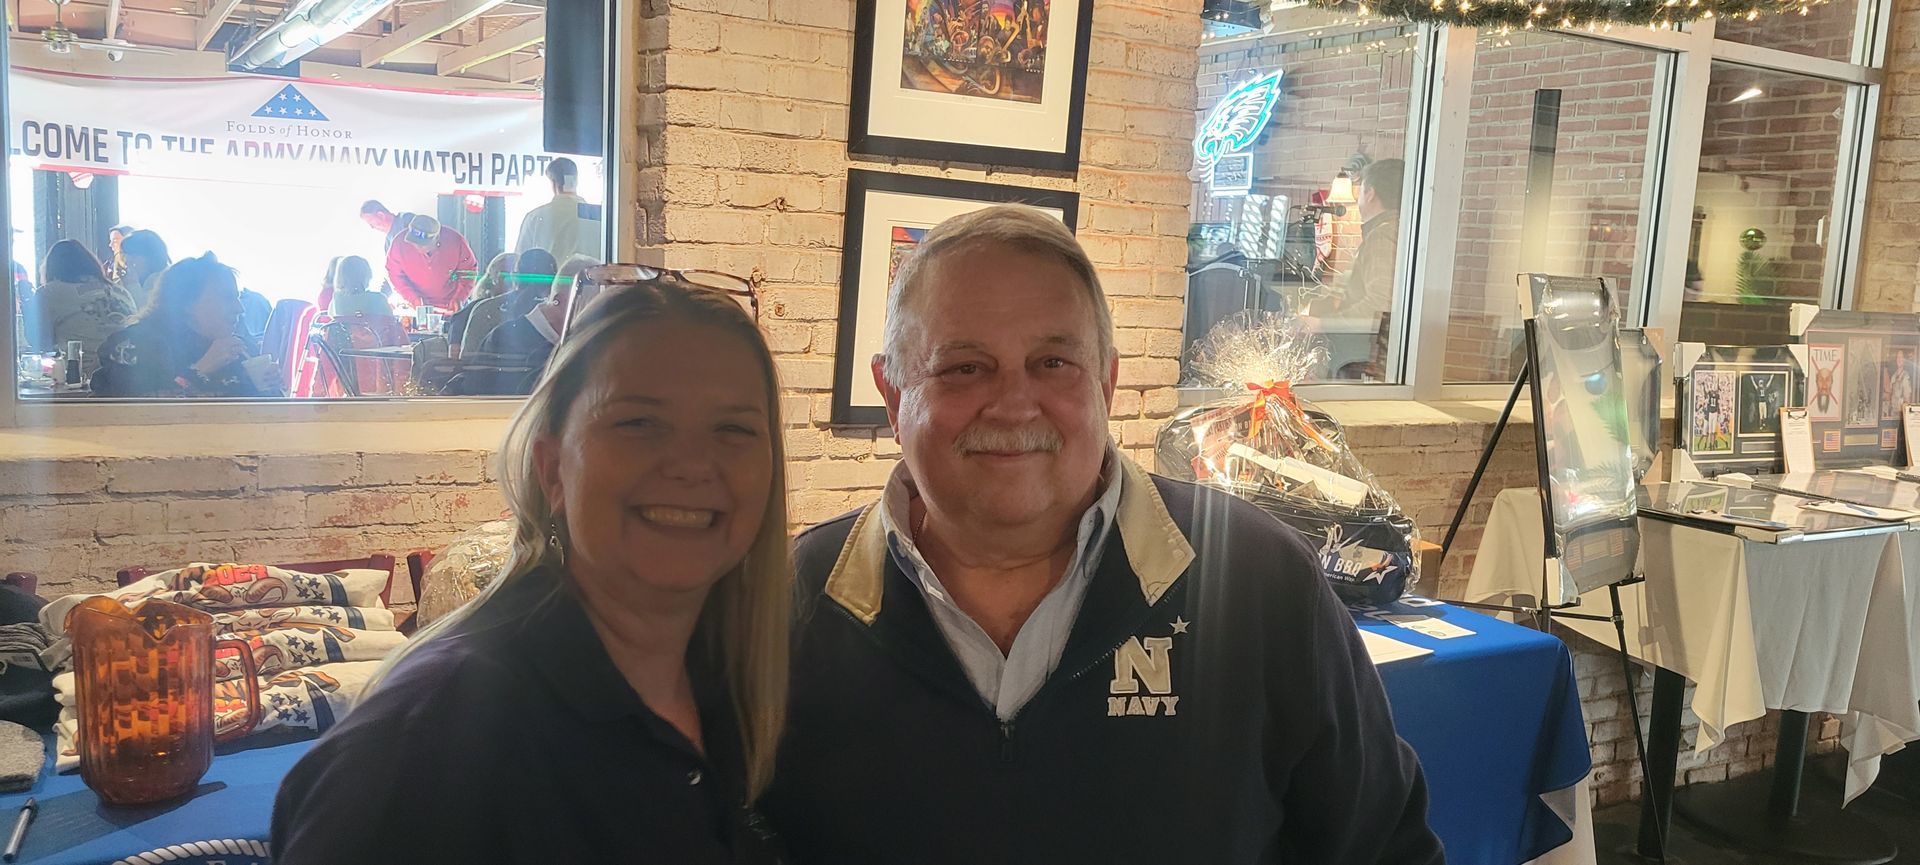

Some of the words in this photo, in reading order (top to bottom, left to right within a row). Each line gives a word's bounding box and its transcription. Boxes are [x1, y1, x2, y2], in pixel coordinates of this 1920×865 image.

[226, 120, 276, 135] FOLDS
[279, 125, 293, 138] of
[297, 125, 353, 139] HONOR
[10, 120, 109, 164] COME
[116, 130, 153, 165] TO
[394, 148, 484, 186] WATCH
[491, 153, 552, 187] PART
[1813, 348, 1838, 362] TIME
[1318, 552, 1332, 570] N
[1334, 557, 1362, 577] BBQ
[1324, 572, 1344, 581] merican
[1110, 635, 1173, 694] N
[1107, 696, 1180, 717] NAVY
